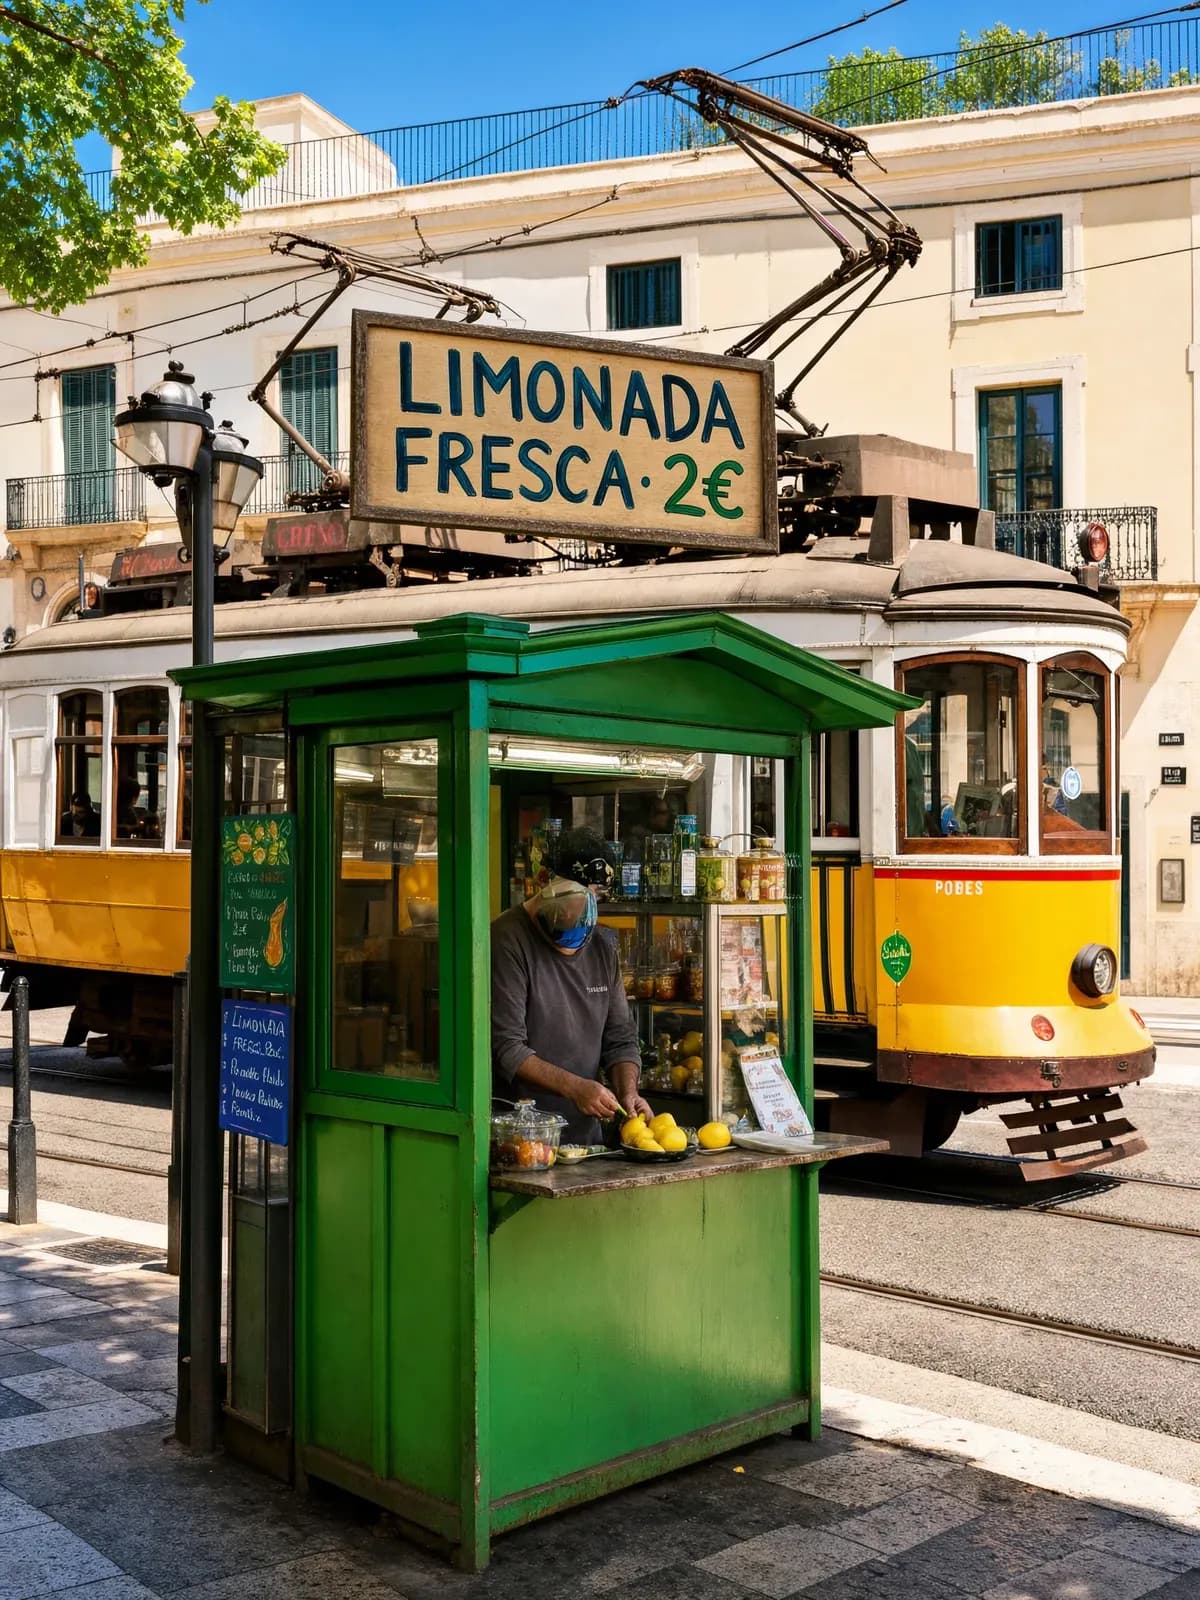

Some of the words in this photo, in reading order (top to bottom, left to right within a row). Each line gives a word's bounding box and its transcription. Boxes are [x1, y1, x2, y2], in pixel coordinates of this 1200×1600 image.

[399, 341, 745, 450] LIMONADA
[395, 427, 634, 510] FRESCA
[664, 453, 744, 520] 2€
[935, 880, 984, 896] POBES
